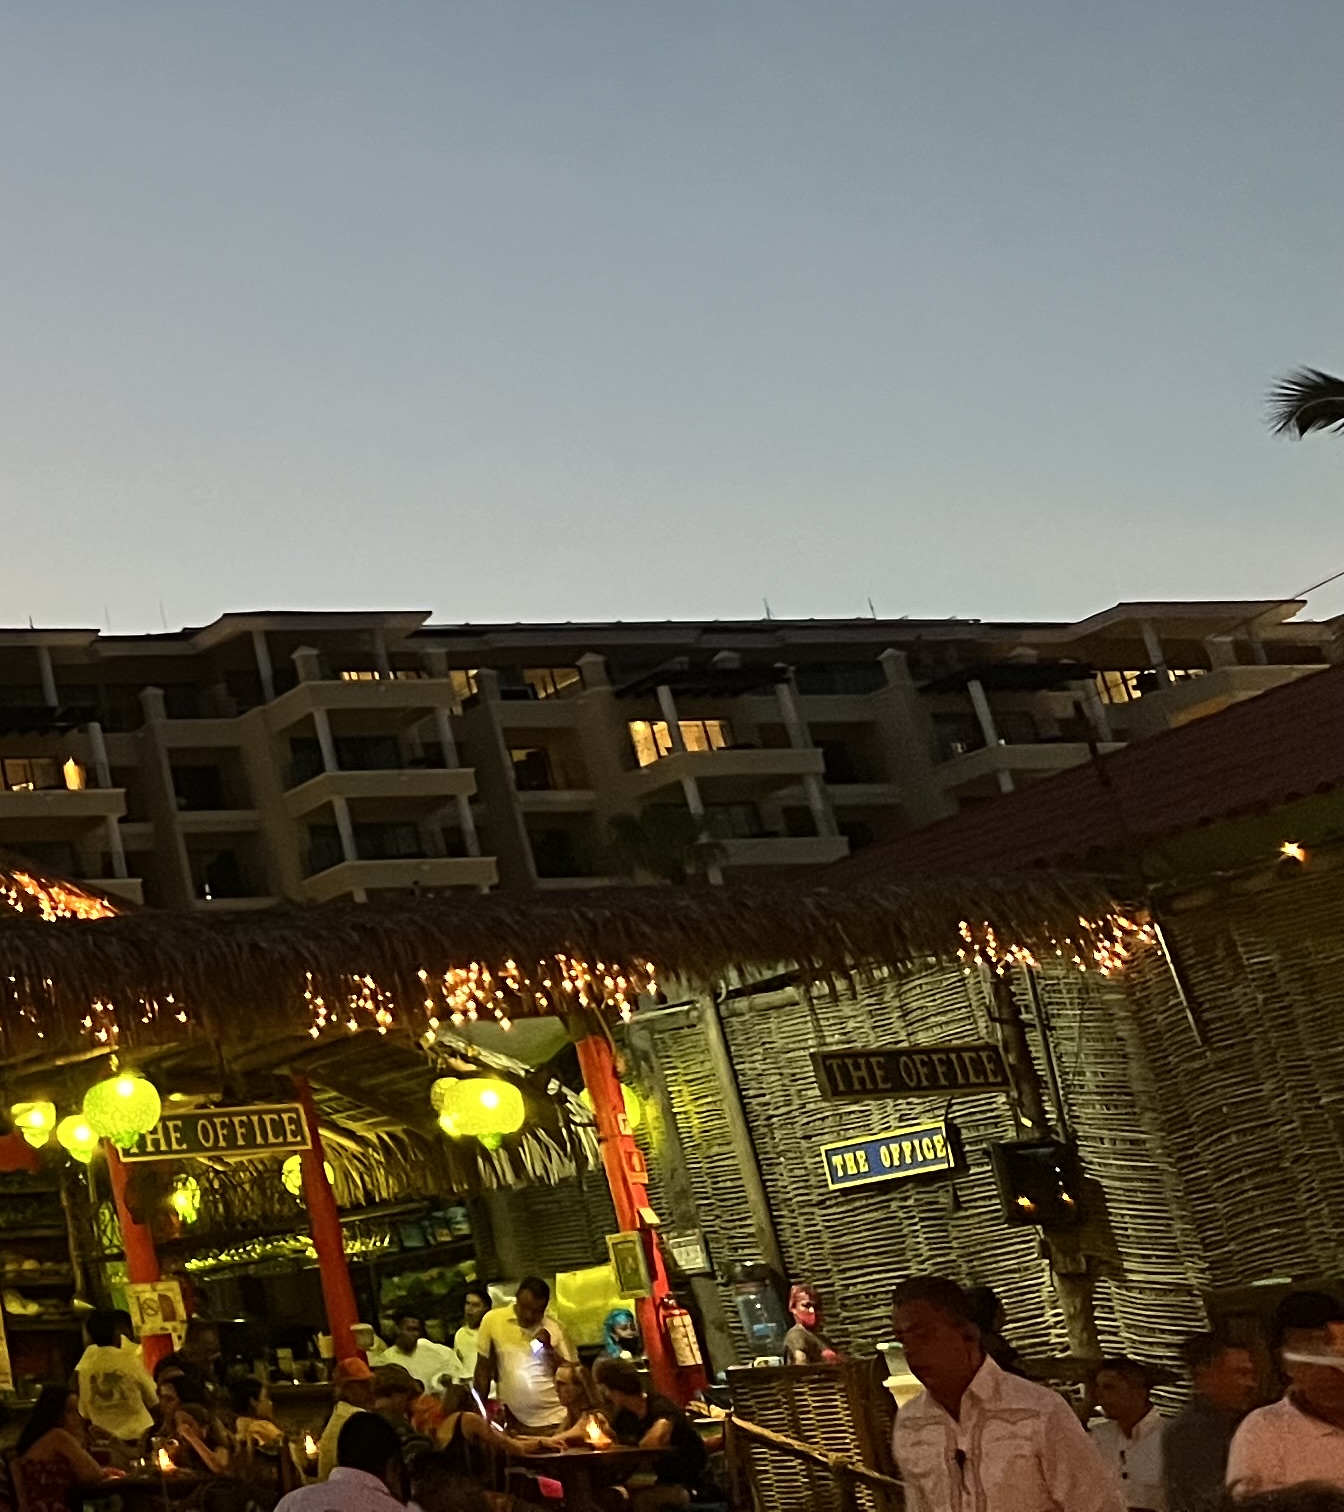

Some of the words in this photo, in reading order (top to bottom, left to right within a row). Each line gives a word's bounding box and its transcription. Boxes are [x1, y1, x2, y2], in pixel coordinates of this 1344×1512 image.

[825, 1056, 892, 1092] THE
[899, 1050, 1003, 1087] OFFICE
[129, 1119, 187, 1154] HE
[197, 1112, 302, 1148] OFFICE
[831, 1149, 869, 1178] THE
[879, 1133, 947, 1169] OFFICE
